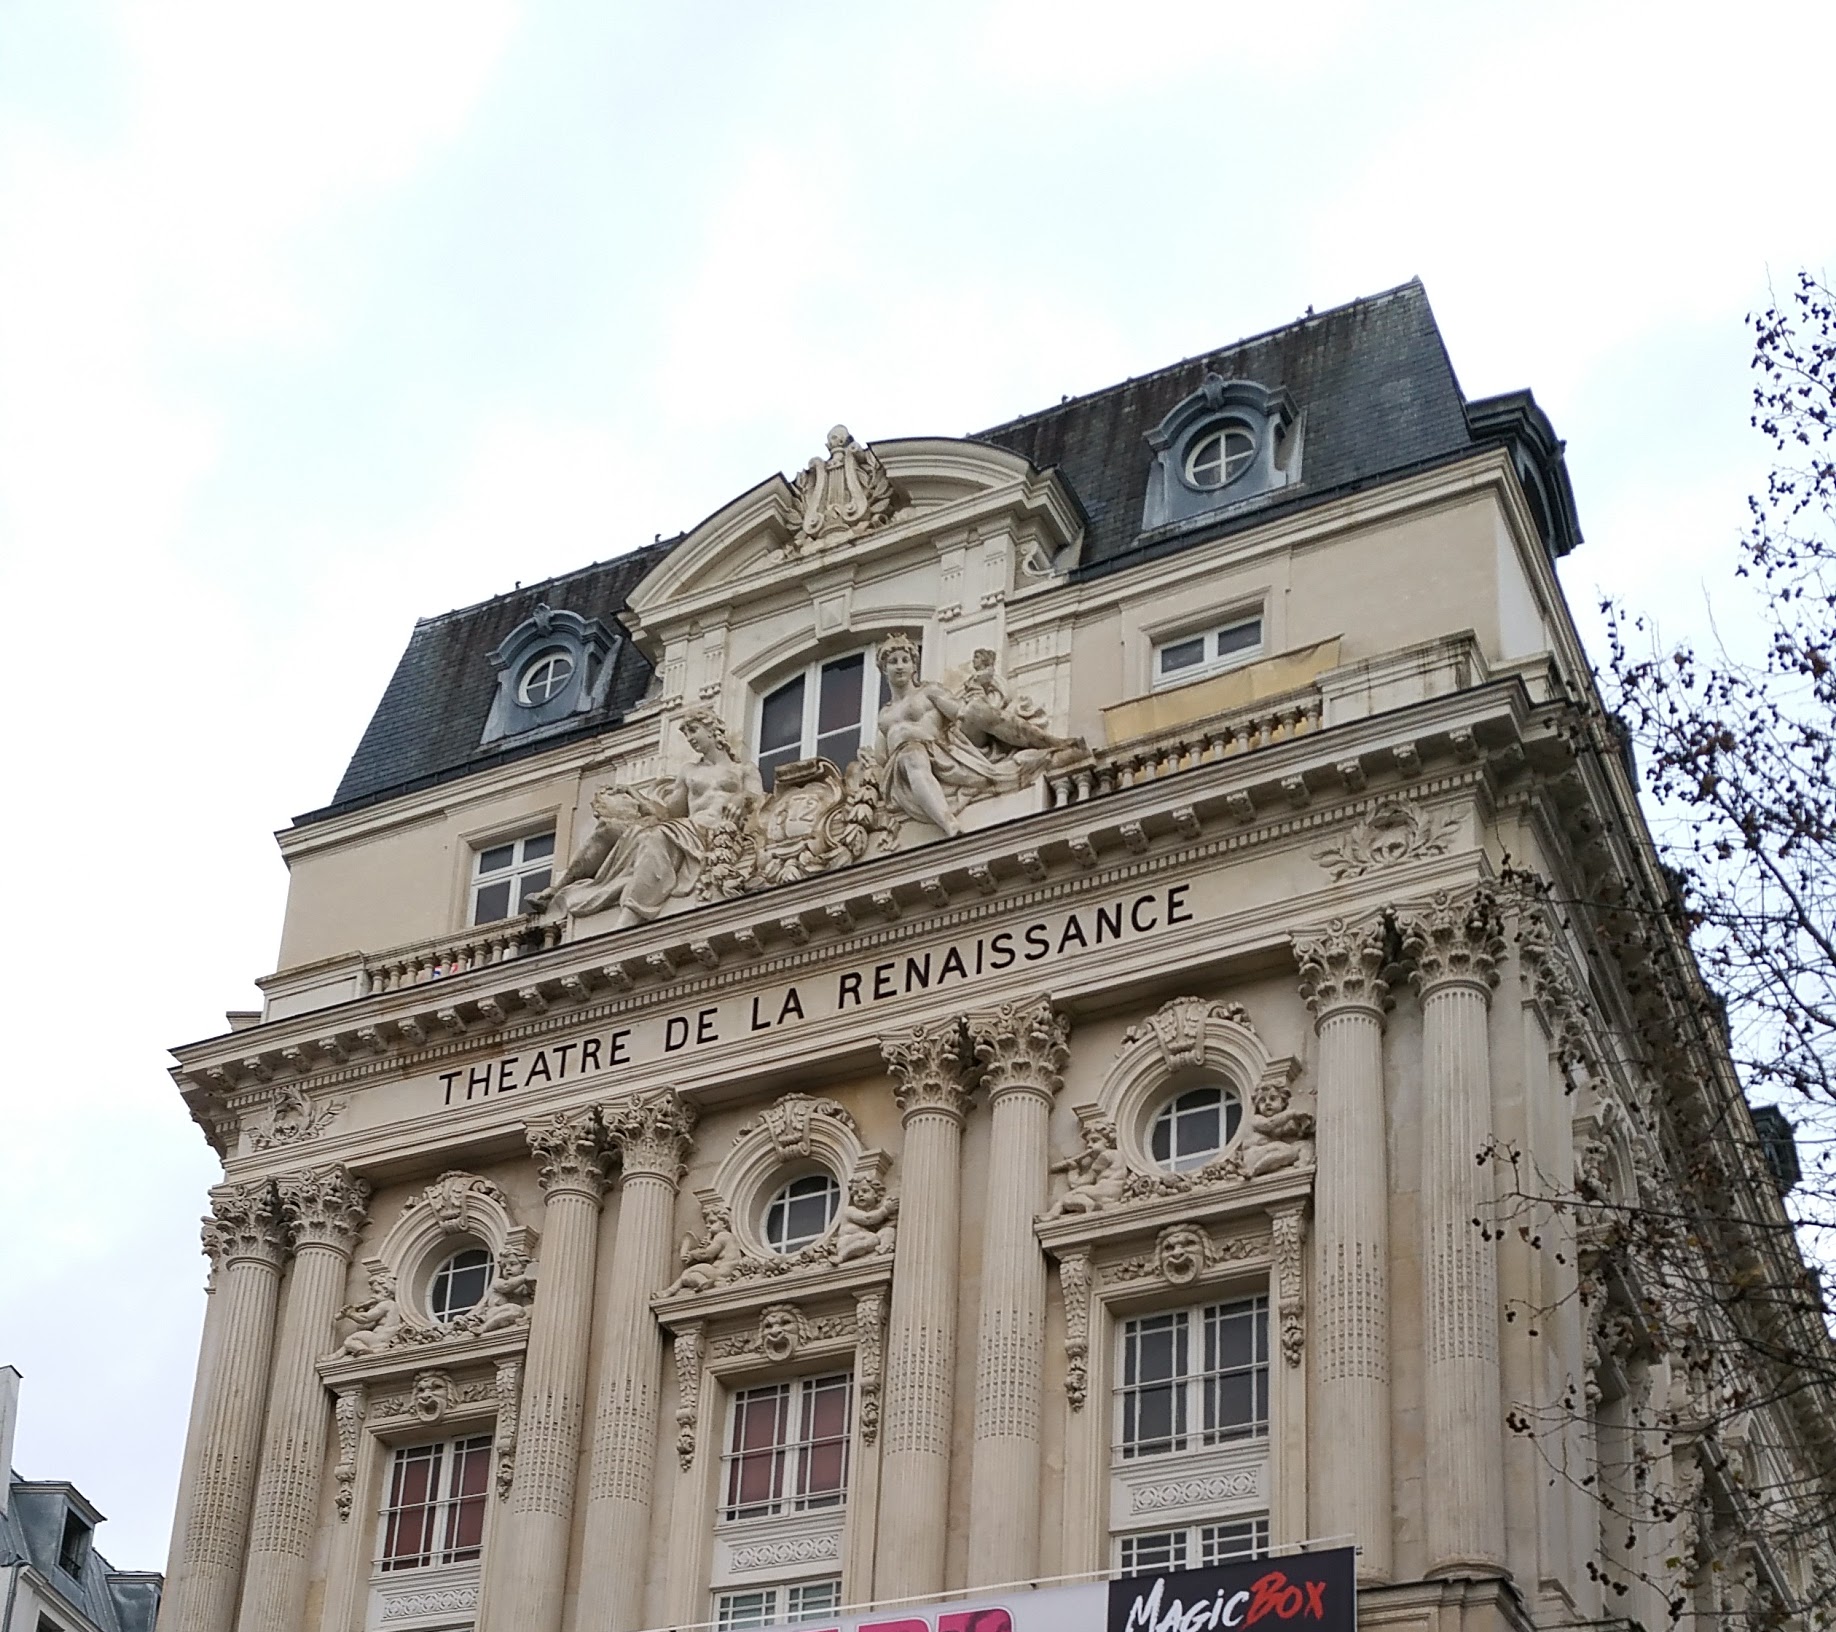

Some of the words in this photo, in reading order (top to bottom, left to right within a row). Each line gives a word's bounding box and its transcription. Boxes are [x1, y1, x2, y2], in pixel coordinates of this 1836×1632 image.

[439, 1029, 632, 1106] THEATRE
[664, 1006, 719, 1052] DE
[750, 987, 806, 1032] LA
[837, 884, 1195, 1011] RENAISSANCE
